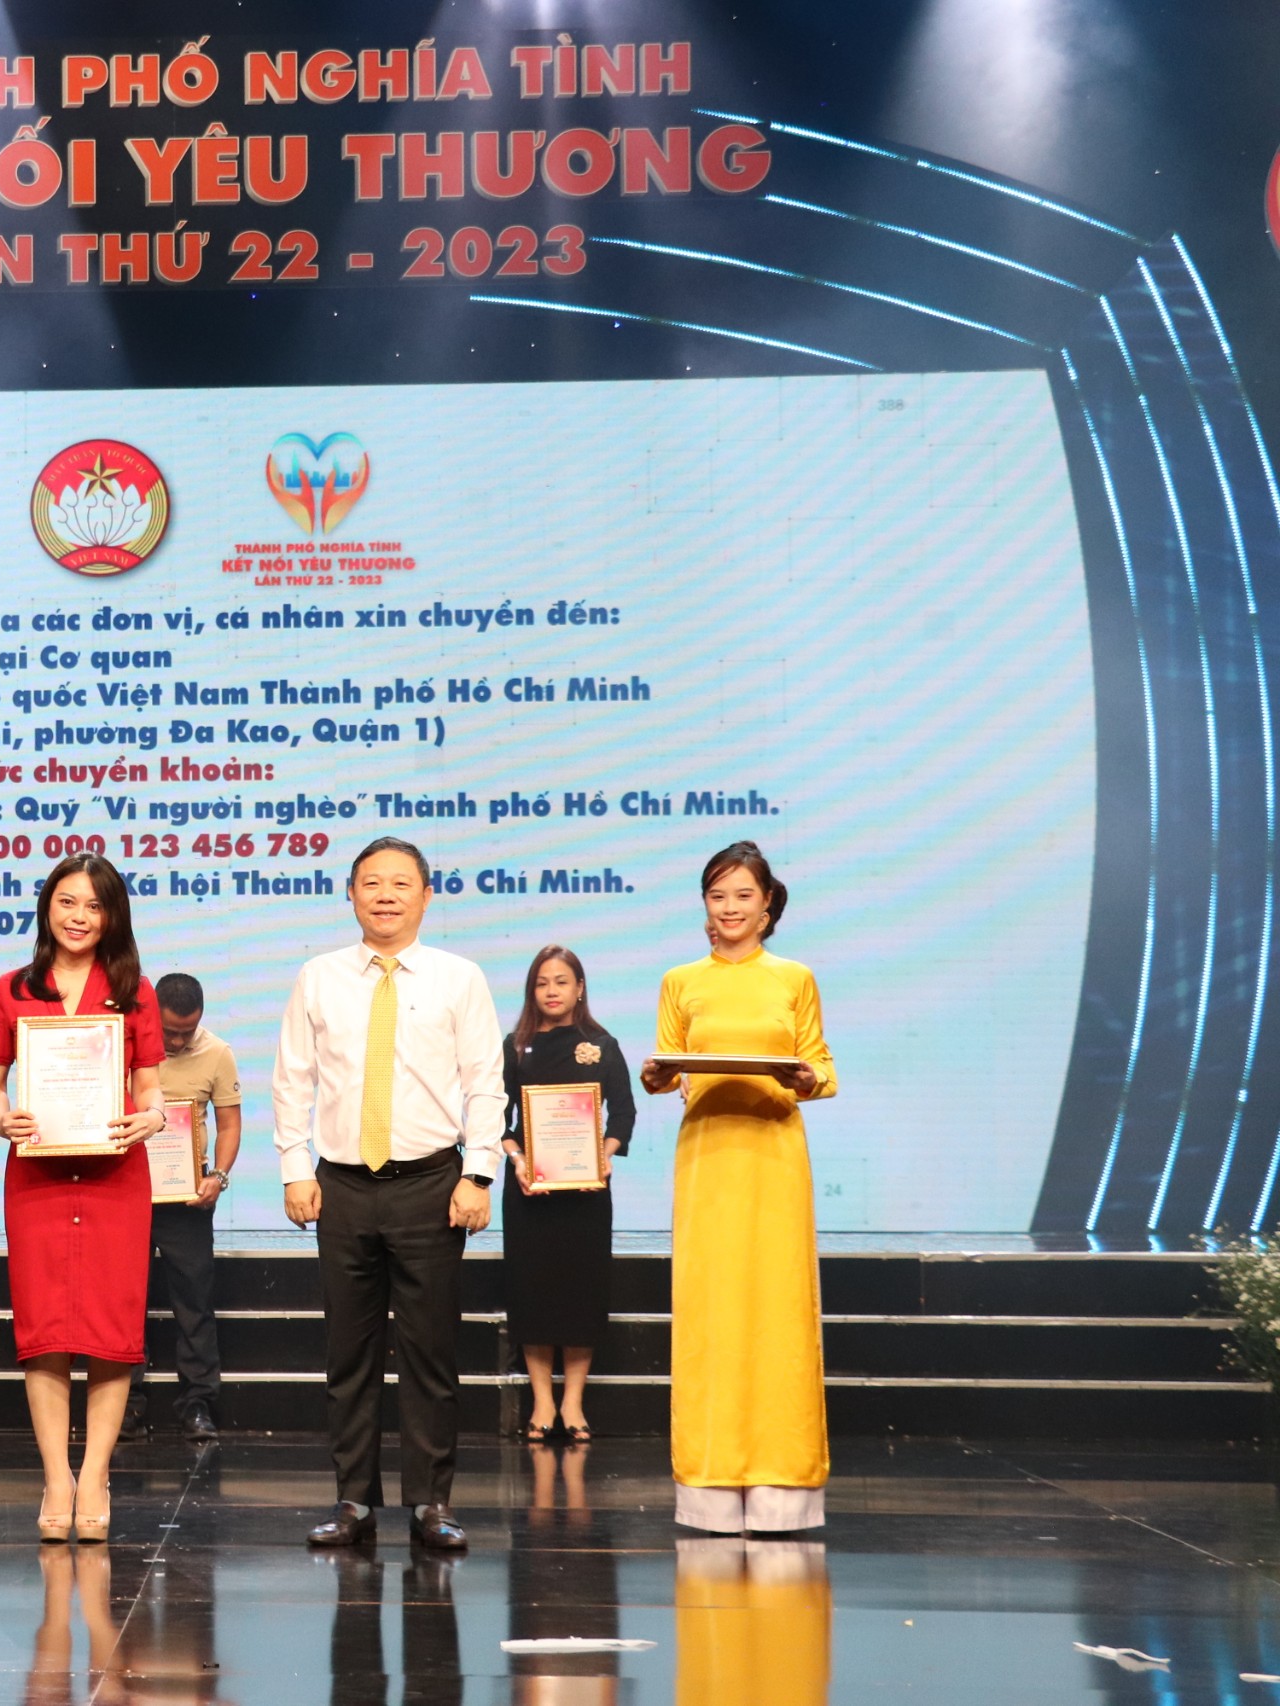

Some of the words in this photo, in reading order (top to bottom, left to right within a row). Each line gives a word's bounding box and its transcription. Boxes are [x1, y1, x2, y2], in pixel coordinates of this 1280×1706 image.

[62, 35, 219, 108] PHỐ
[244, 37, 493, 105] NGHĨA
[510, 33, 691, 98] TÌNH
[124, 122, 308, 207] YÊU
[341, 125, 772, 203] THƯƠNG
[57, 220, 210, 285] THỨ
[228, 230, 319, 283] 22
[346, 252, 373, 271] -
[400, 224, 587, 281] 2023
[317, 575, 334, 586] 22
[348, 575, 382, 586] 2023
[31, 608, 81, 632] các
[91, 605, 153, 632] đơn
[162, 606, 206, 637] vị,
[215, 605, 250, 631] cá
[261, 603, 344, 629] nhân
[354, 603, 407, 628] xin
[418, 599, 535, 633] chuyển
[546, 599, 621, 626] đến:
[39, 644, 81, 670] Cơ
[90, 649, 173, 676] quan
[12, 681, 87, 715] quốc
[96, 681, 163, 713] Việt
[174, 681, 249, 706] Nam
[259, 678, 362, 705] Thành
[373, 676, 436, 711] phố
[447, 676, 492, 704] Hồ
[503, 676, 555, 703] Chí
[566, 675, 651, 703] Minh
[34, 719, 158, 752] phường
[168, 719, 215, 744] Đa
[226, 718, 302, 748] Kao,
[311, 717, 400, 749] Quận
[414, 715, 446, 748] 1)
[33, 755, 148, 789] chuyển
[160, 756, 274, 782] khoản:
[14, 795, 81, 828] Quỹ
[148, 794, 243, 827] người
[374, 791, 478, 819] Thành
[488, 790, 552, 825] phố
[563, 790, 609, 817] Hồ
[619, 790, 672, 817] Chí
[682, 789, 780, 816] Minh.
[120, 833, 180, 858] 123
[191, 833, 255, 858] 456
[267, 832, 330, 857] 789
[169, 870, 221, 903] hội
[231, 869, 334, 896] Thành
[475, 867, 528, 895] Chí
[538, 867, 635, 894] Minh.
